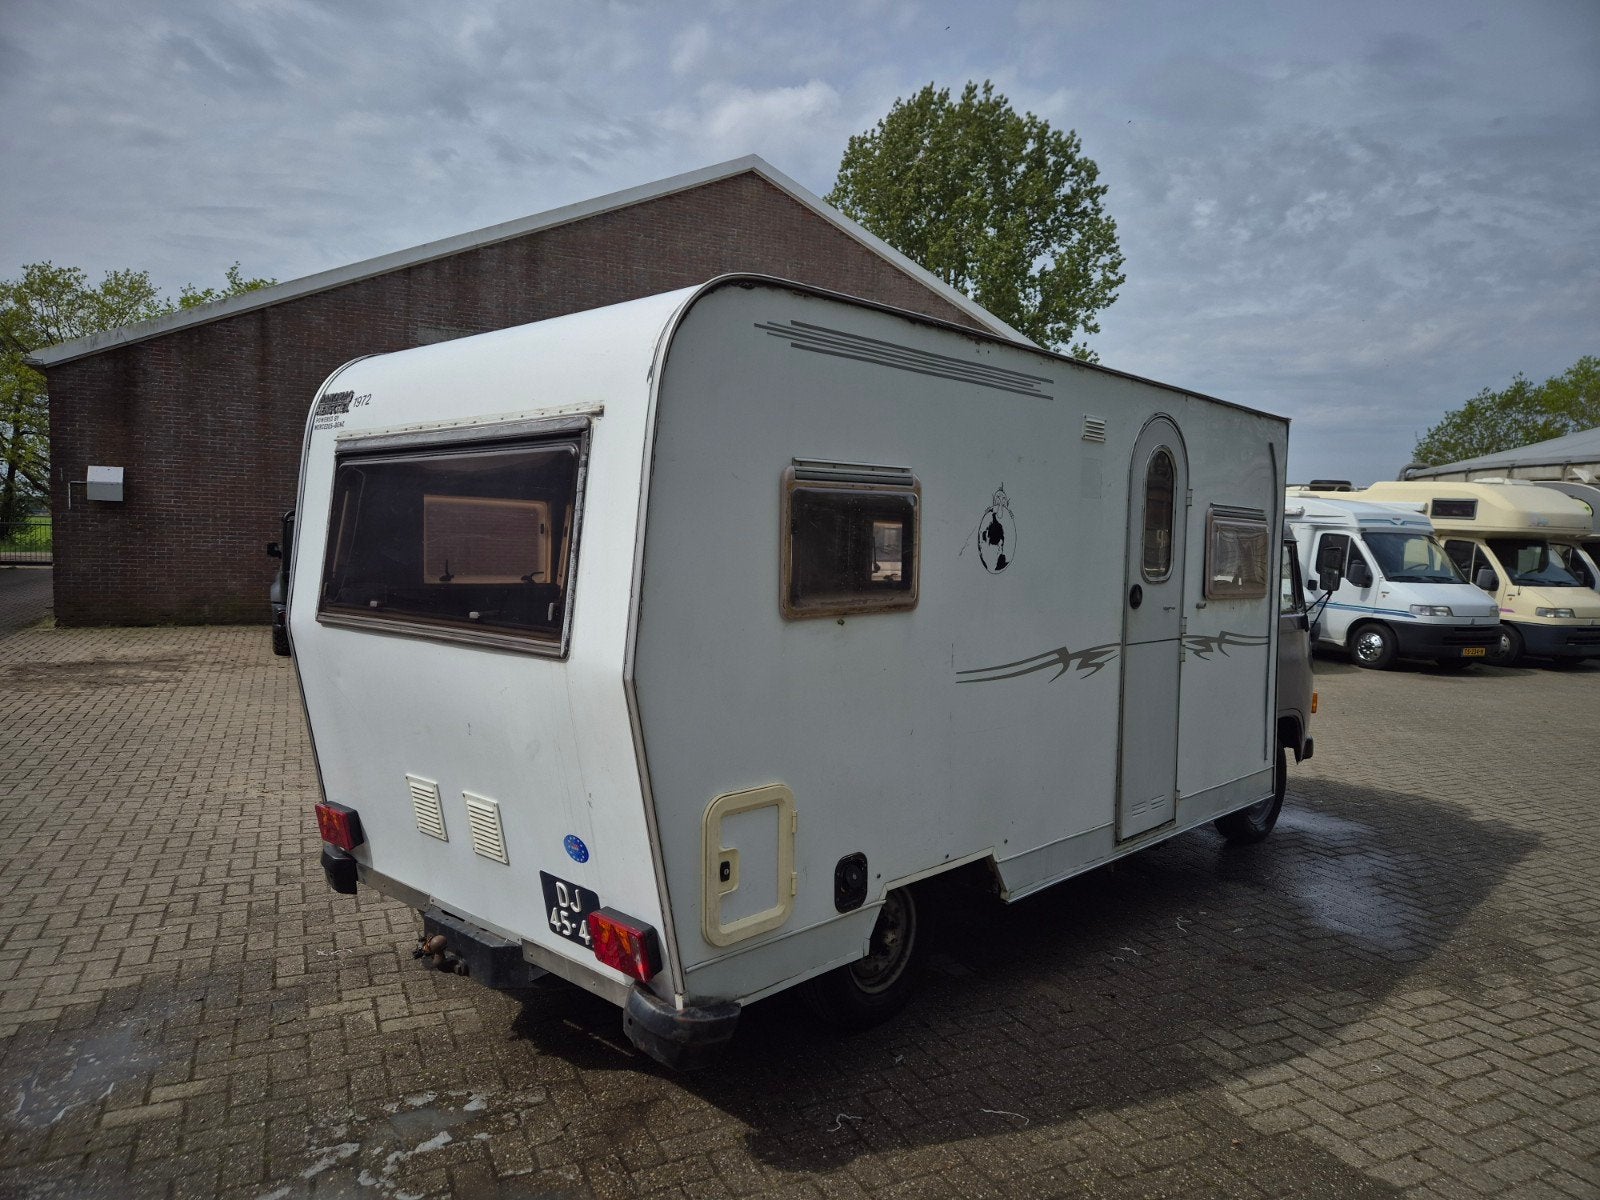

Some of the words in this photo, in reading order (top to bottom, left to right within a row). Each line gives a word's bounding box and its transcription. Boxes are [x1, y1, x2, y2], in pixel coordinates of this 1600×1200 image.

[353, 393, 372, 408] 1972
[555, 881, 581, 913] DJ
[550, 907, 592, 945] 45-4
